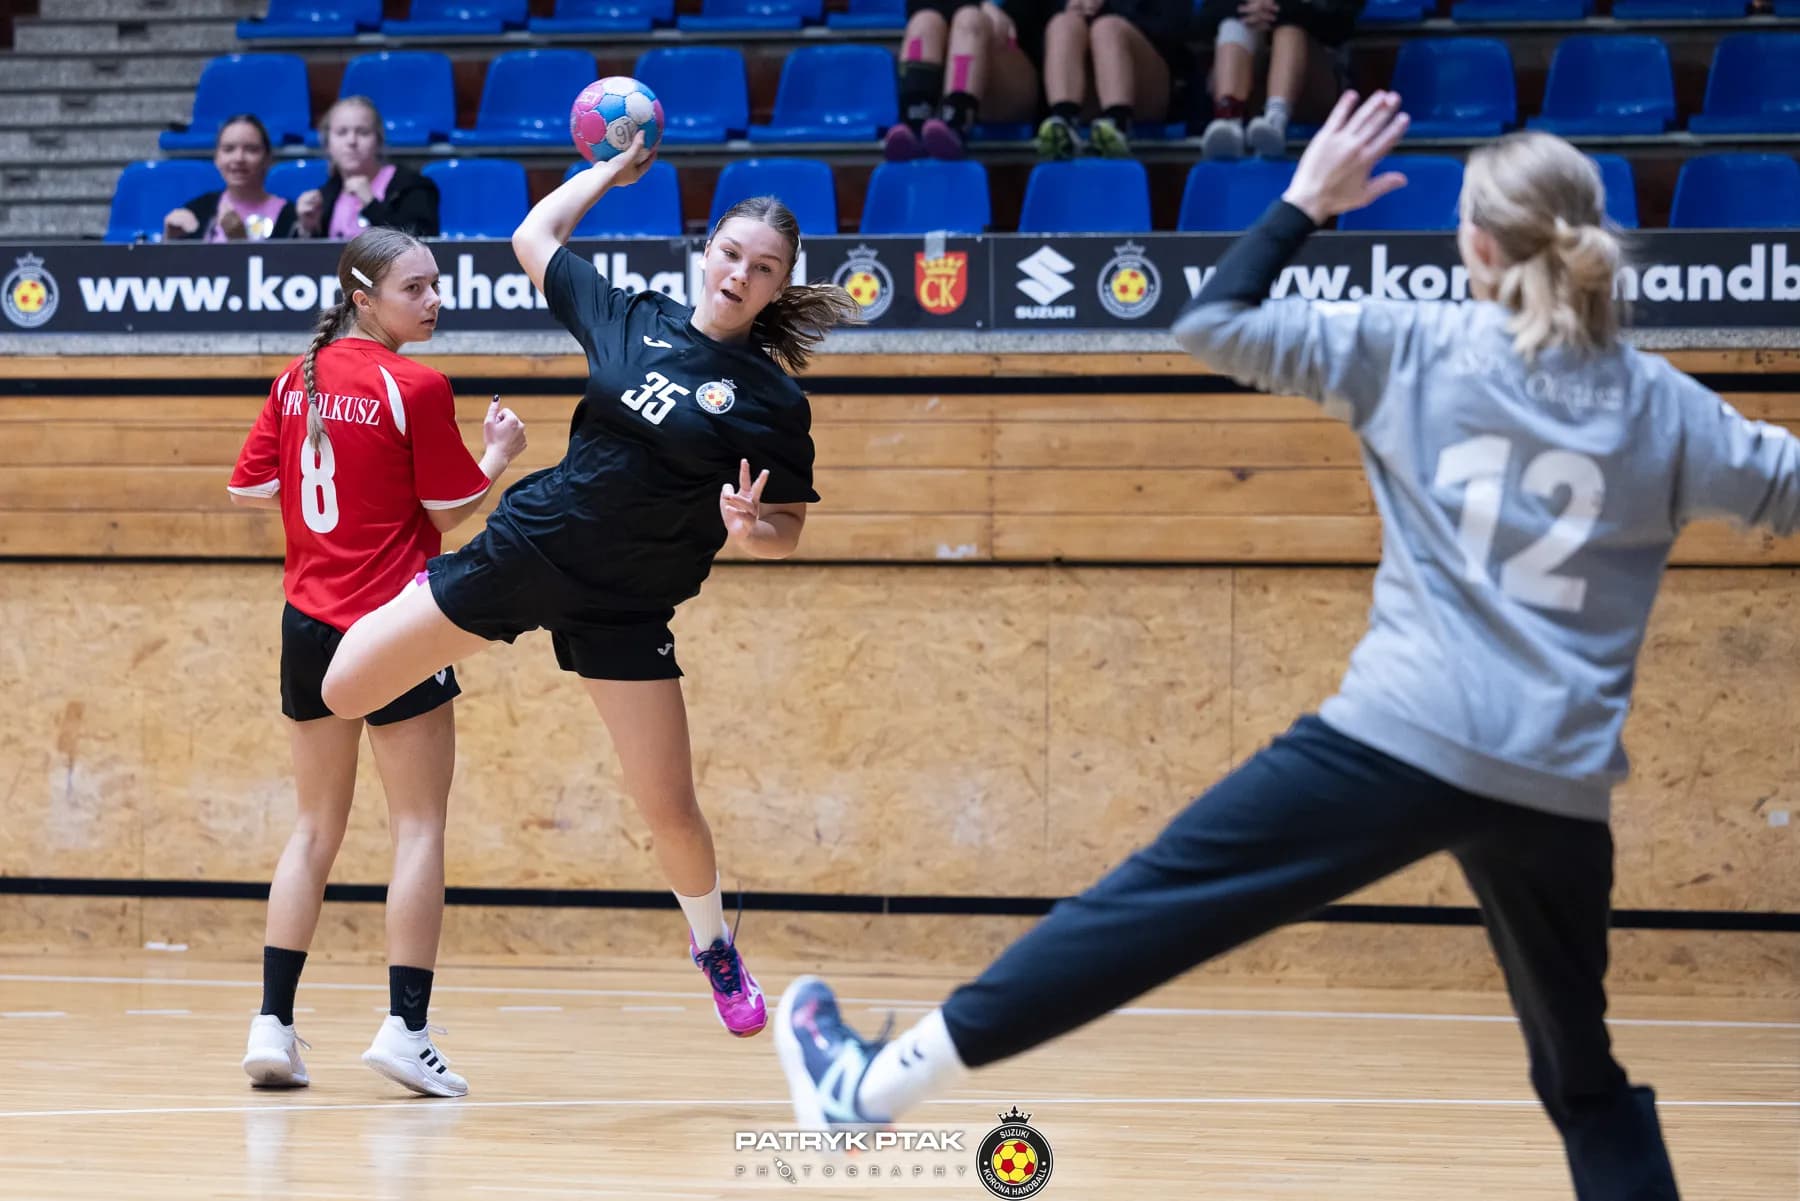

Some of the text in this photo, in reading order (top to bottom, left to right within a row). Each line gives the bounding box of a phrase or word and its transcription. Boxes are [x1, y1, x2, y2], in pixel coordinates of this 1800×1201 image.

[920, 277, 959, 308] CK
[1014, 305, 1076, 320] SUZUKI
[283, 390, 304, 416] PR
[621, 371, 691, 425] 35
[301, 433, 339, 533] 8
[1434, 435, 1605, 613] 12
